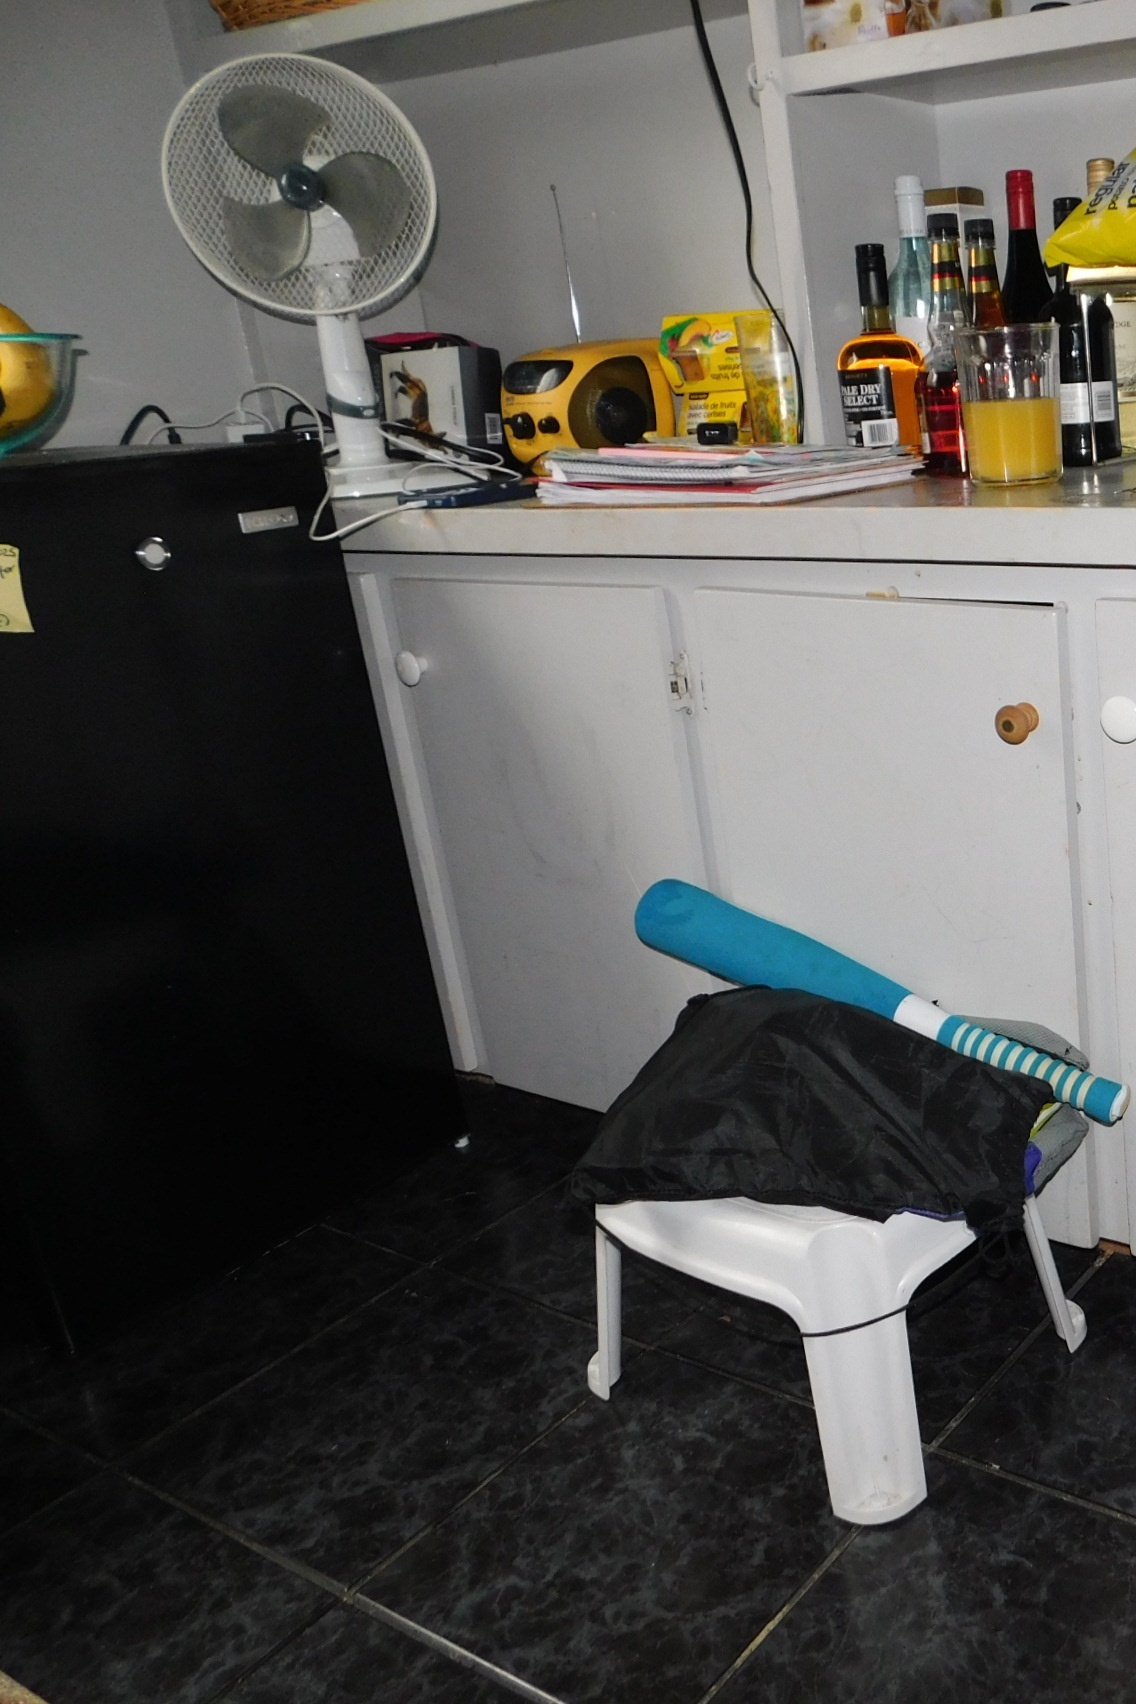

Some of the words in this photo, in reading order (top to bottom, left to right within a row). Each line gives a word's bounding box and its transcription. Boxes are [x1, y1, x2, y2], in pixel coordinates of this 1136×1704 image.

[1084, 161, 1130, 216] regular
[860, 383, 881, 395] DRY
[720, 401, 737, 409] fruits
[843, 394, 879, 407] SELECT
